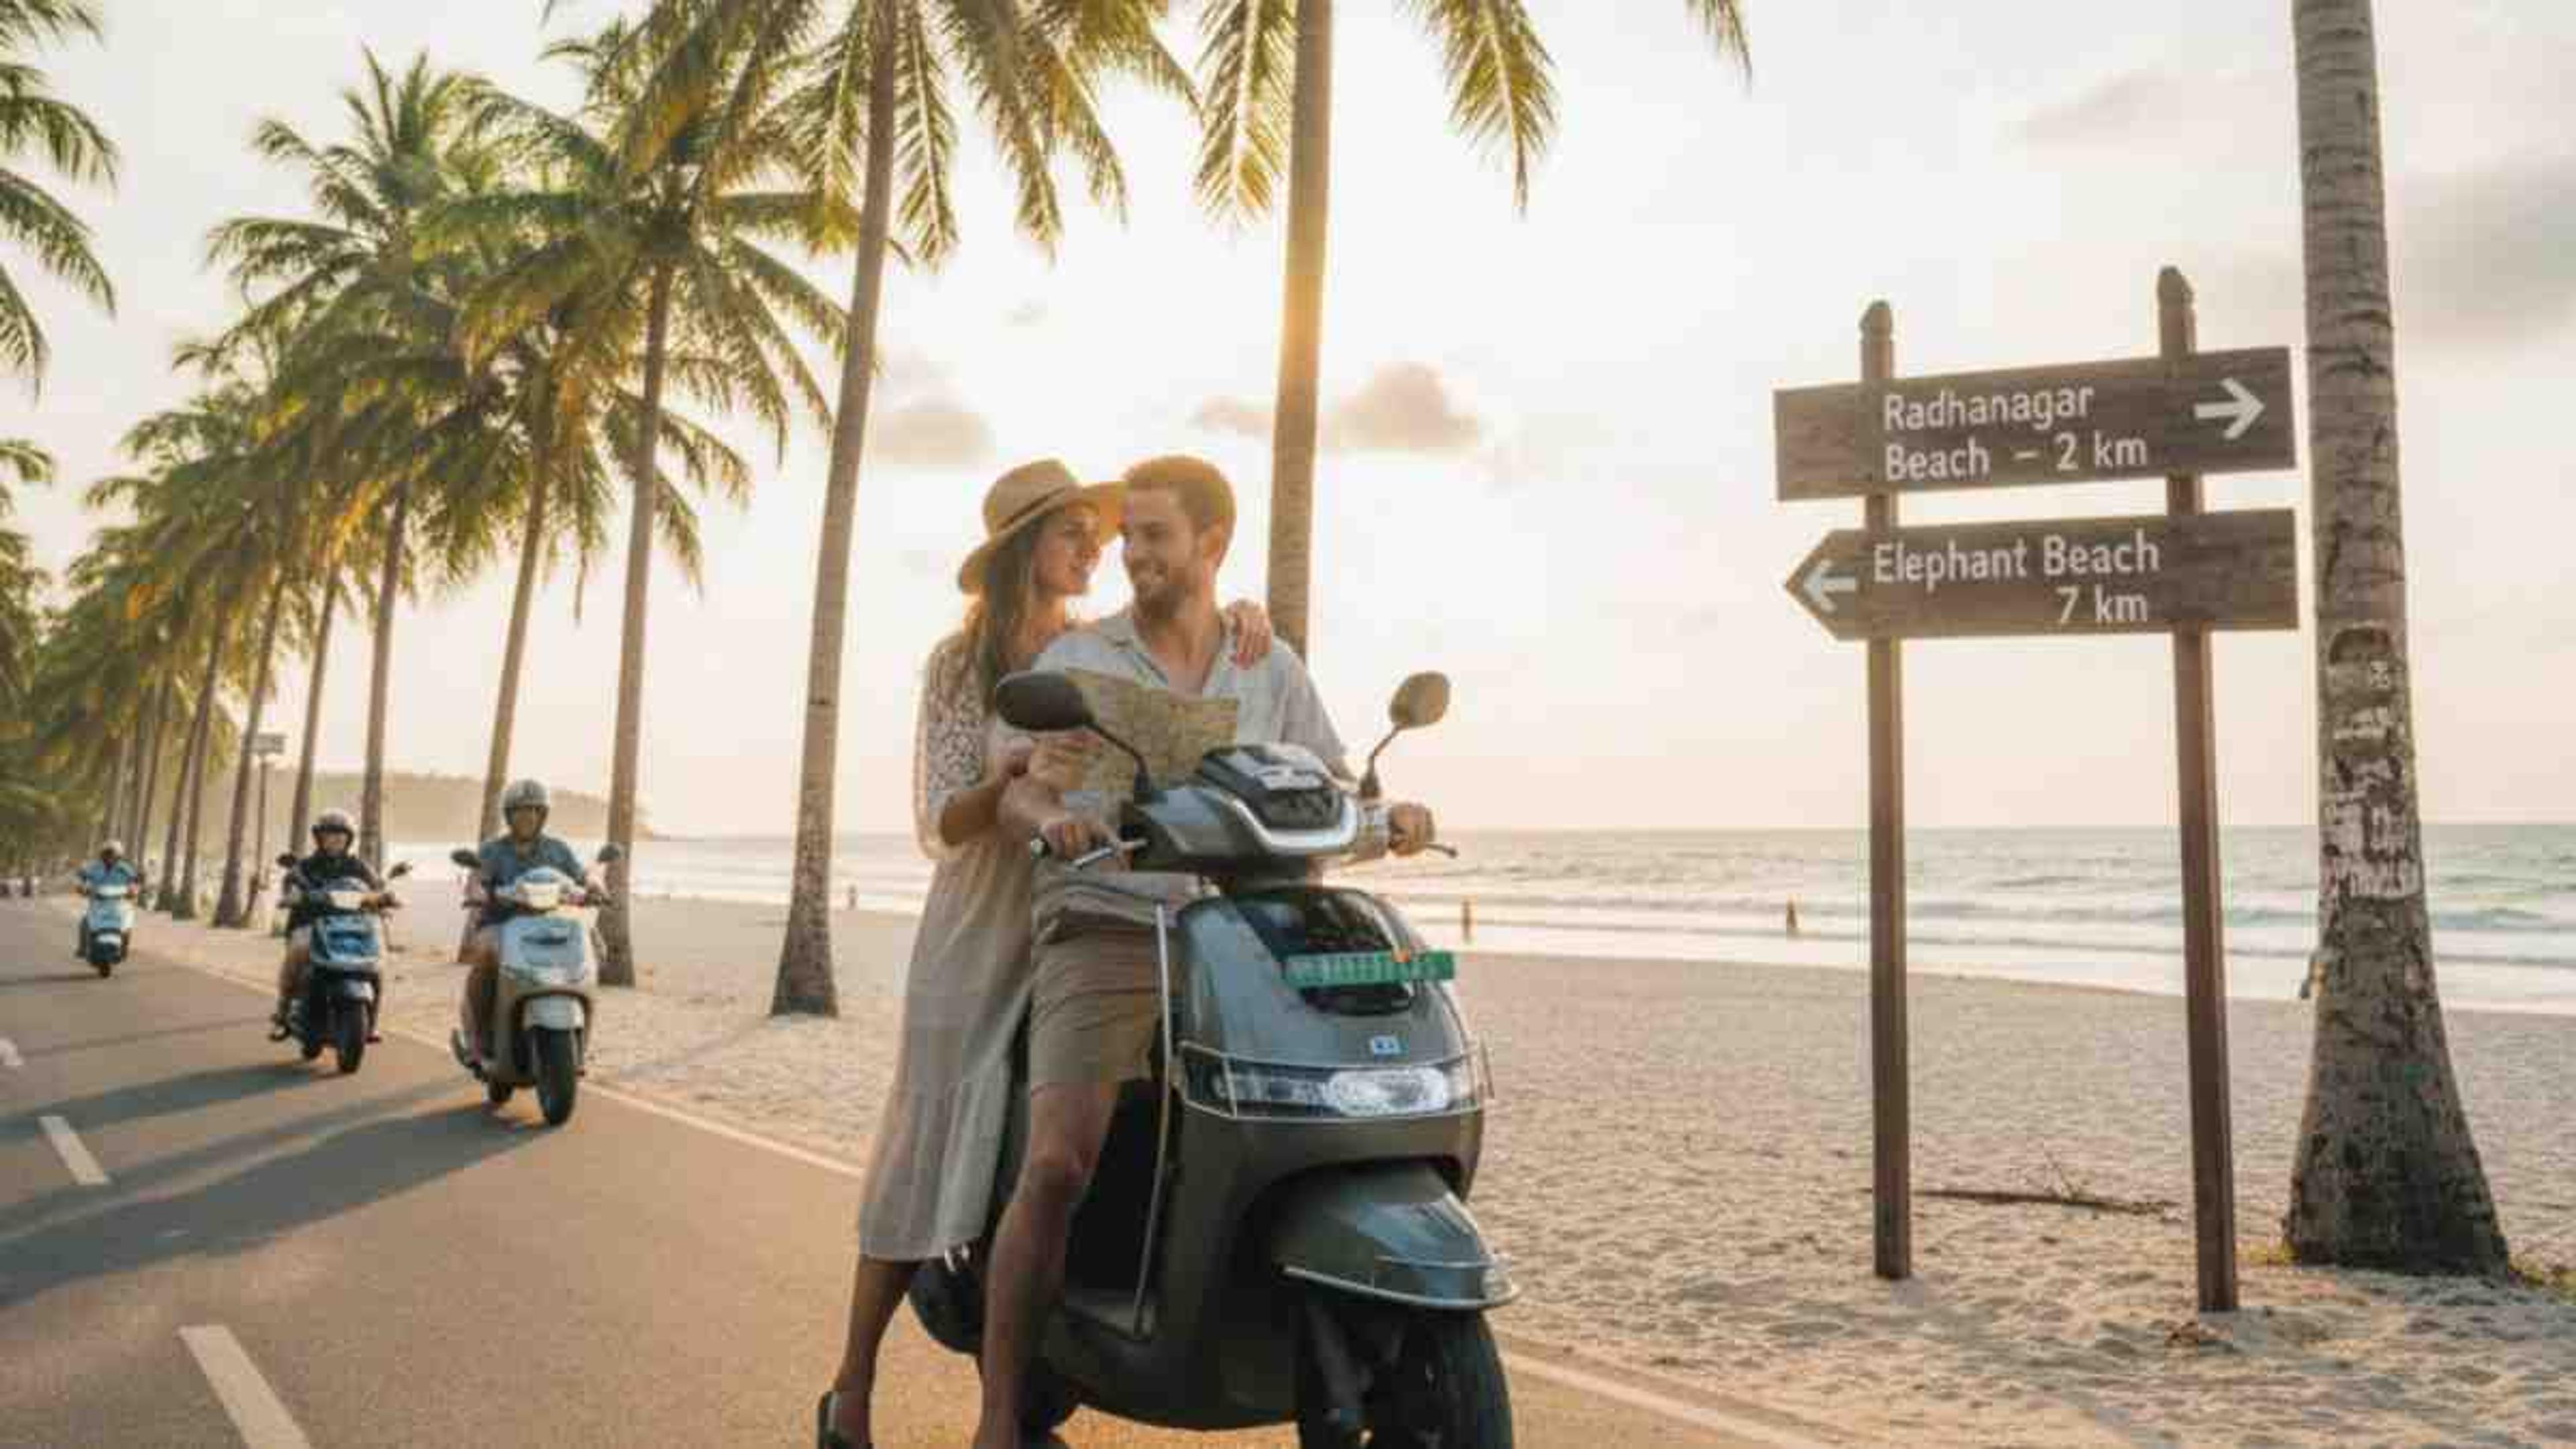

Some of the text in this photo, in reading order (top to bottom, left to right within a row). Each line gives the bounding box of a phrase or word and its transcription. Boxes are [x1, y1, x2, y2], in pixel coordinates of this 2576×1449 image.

[1885, 386, 2094, 431] Radhanagar
[1886, 438, 1990, 481] Beach
[2056, 434, 2079, 472] 2
[2094, 429, 2147, 468] km
[1874, 529, 2160, 591] Elephant Beach
[2057, 582, 2148, 624] 7 km
